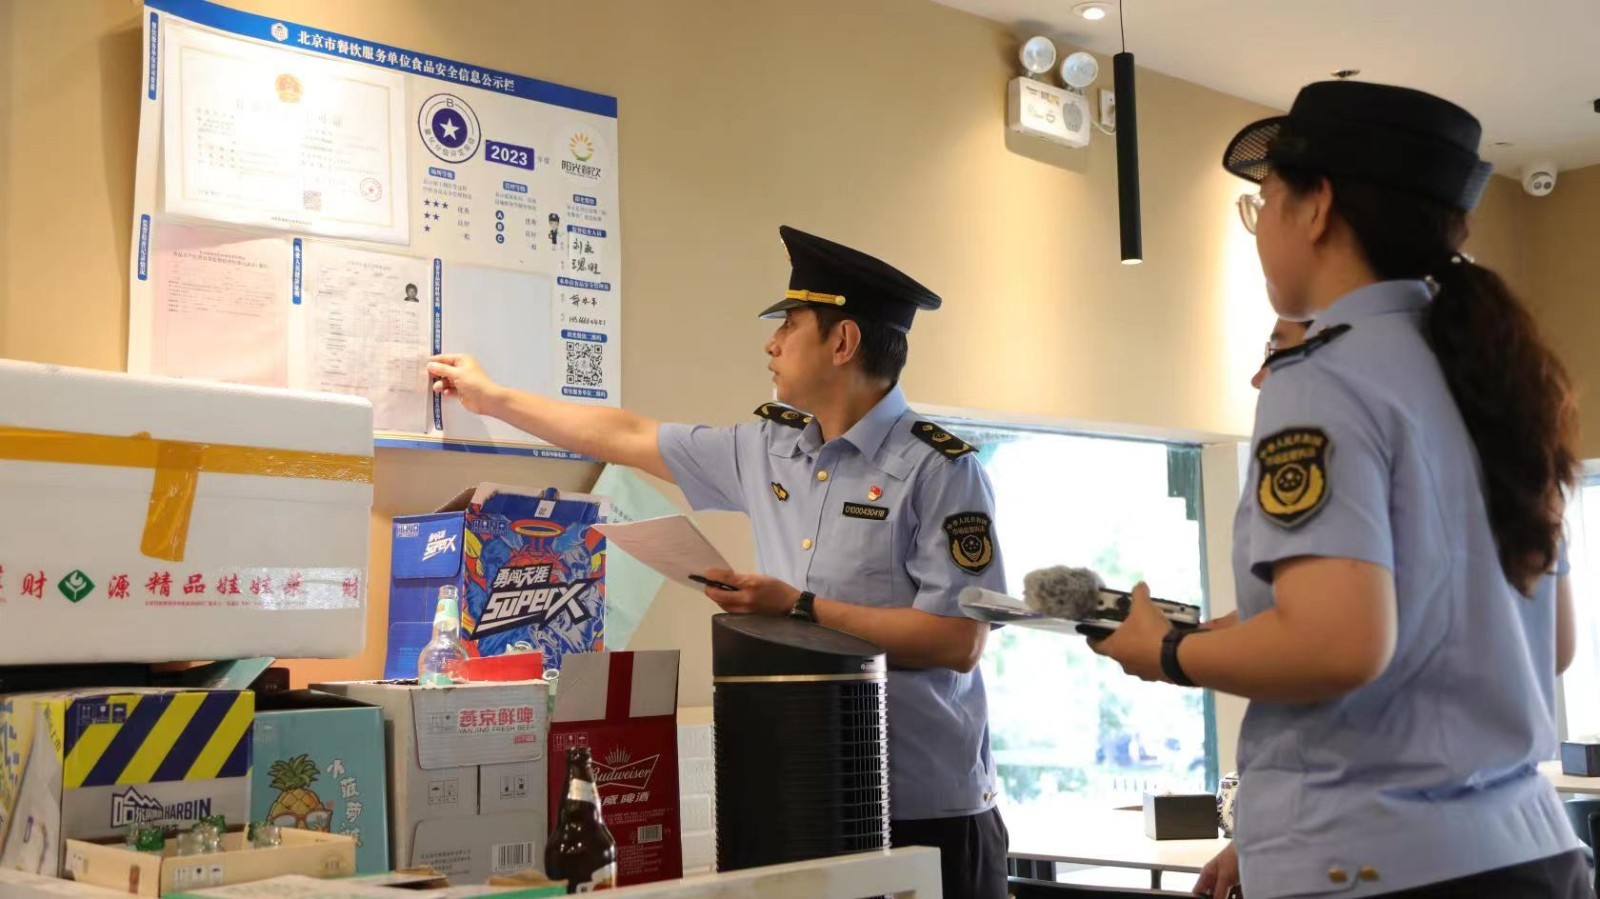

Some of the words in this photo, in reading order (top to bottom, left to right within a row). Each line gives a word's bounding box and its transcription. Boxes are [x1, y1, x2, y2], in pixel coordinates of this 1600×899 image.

[297, 30, 515, 92] 北京市餐饮服务单位食品安全信息公示栏
[446, 98, 454, 107] B
[490, 145, 528, 166] 2023
[20, 570, 48, 599] 财
[493, 564, 550, 590] 勇闯天涯
[459, 706, 535, 727] 燕京鲜啤
[459, 726, 488, 735] YANJING
[492, 725, 516, 733] FRESH
[591, 766, 652, 783] Budweiser
[600, 791, 651, 806] 威啤酒
[164, 798, 212, 821] HARBIN
